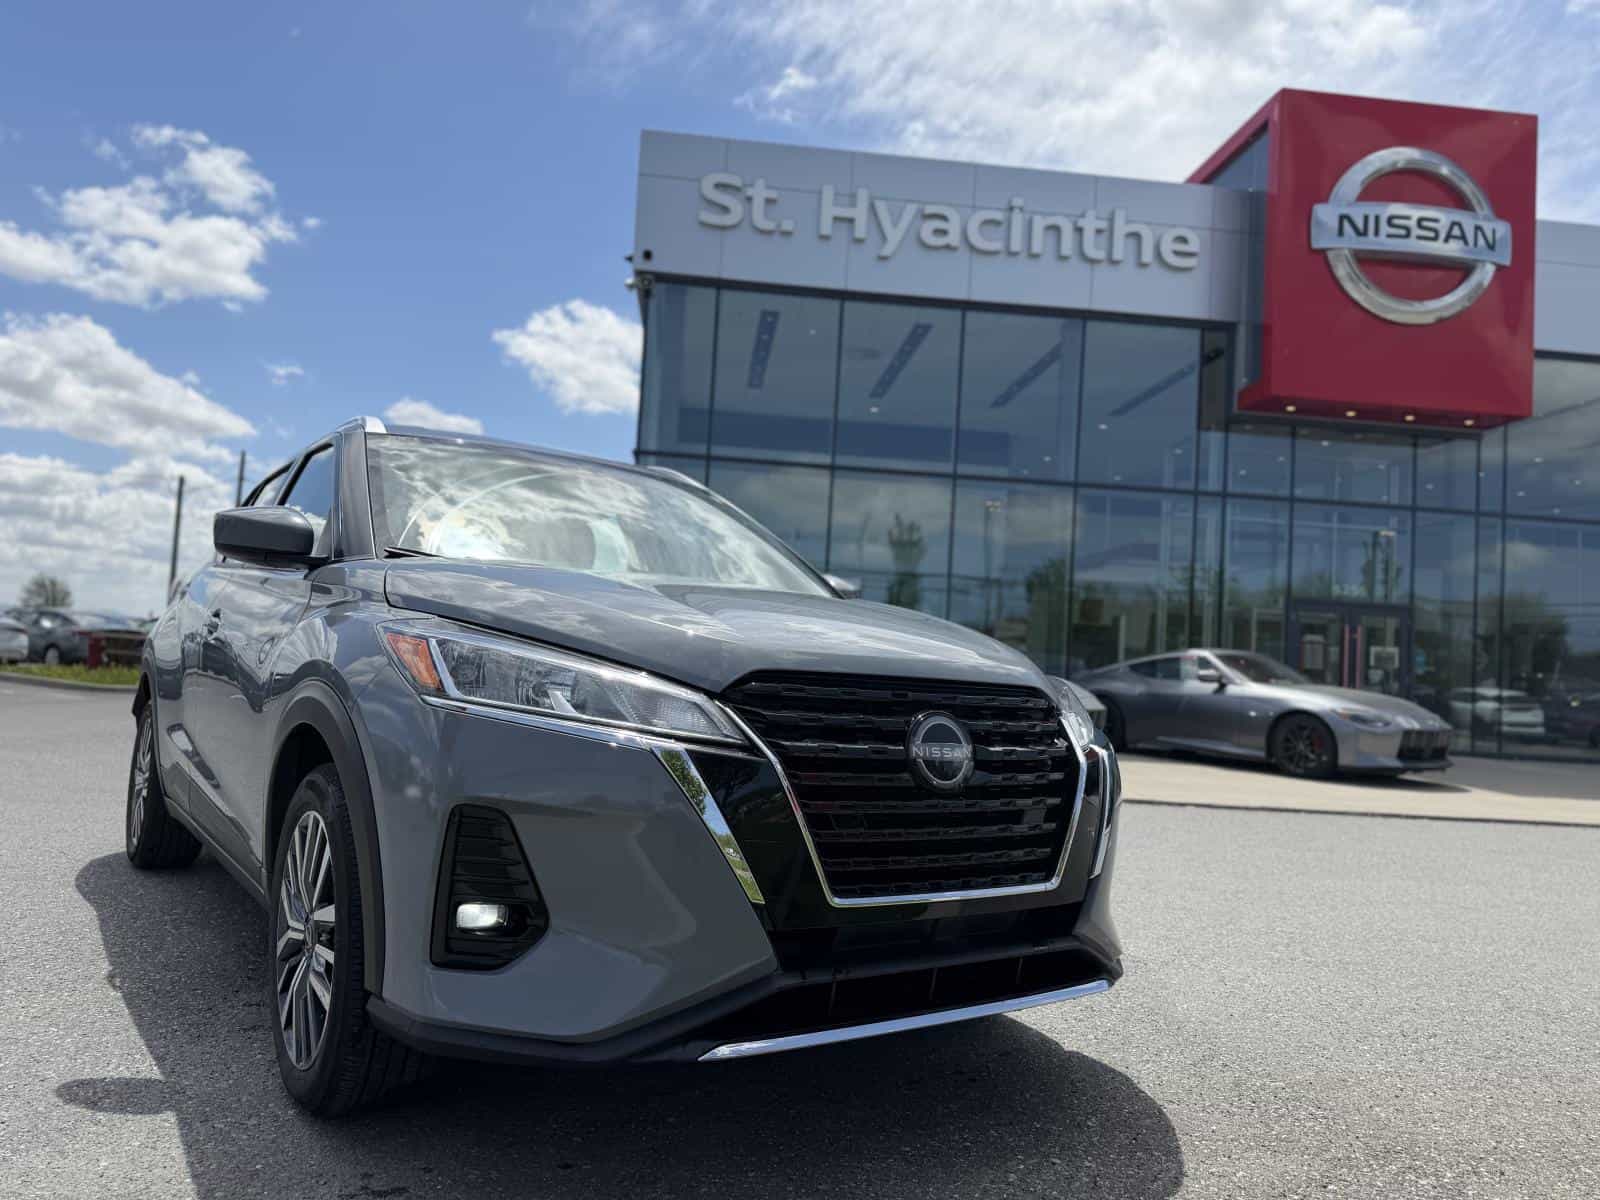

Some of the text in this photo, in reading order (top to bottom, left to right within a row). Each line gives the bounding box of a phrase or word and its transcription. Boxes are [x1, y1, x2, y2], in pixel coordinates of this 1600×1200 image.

[699, 173, 1200, 269] St. Hyacinthe
[1336, 213, 1497, 252] NISSAN
[912, 745, 972, 758] NISSAN
